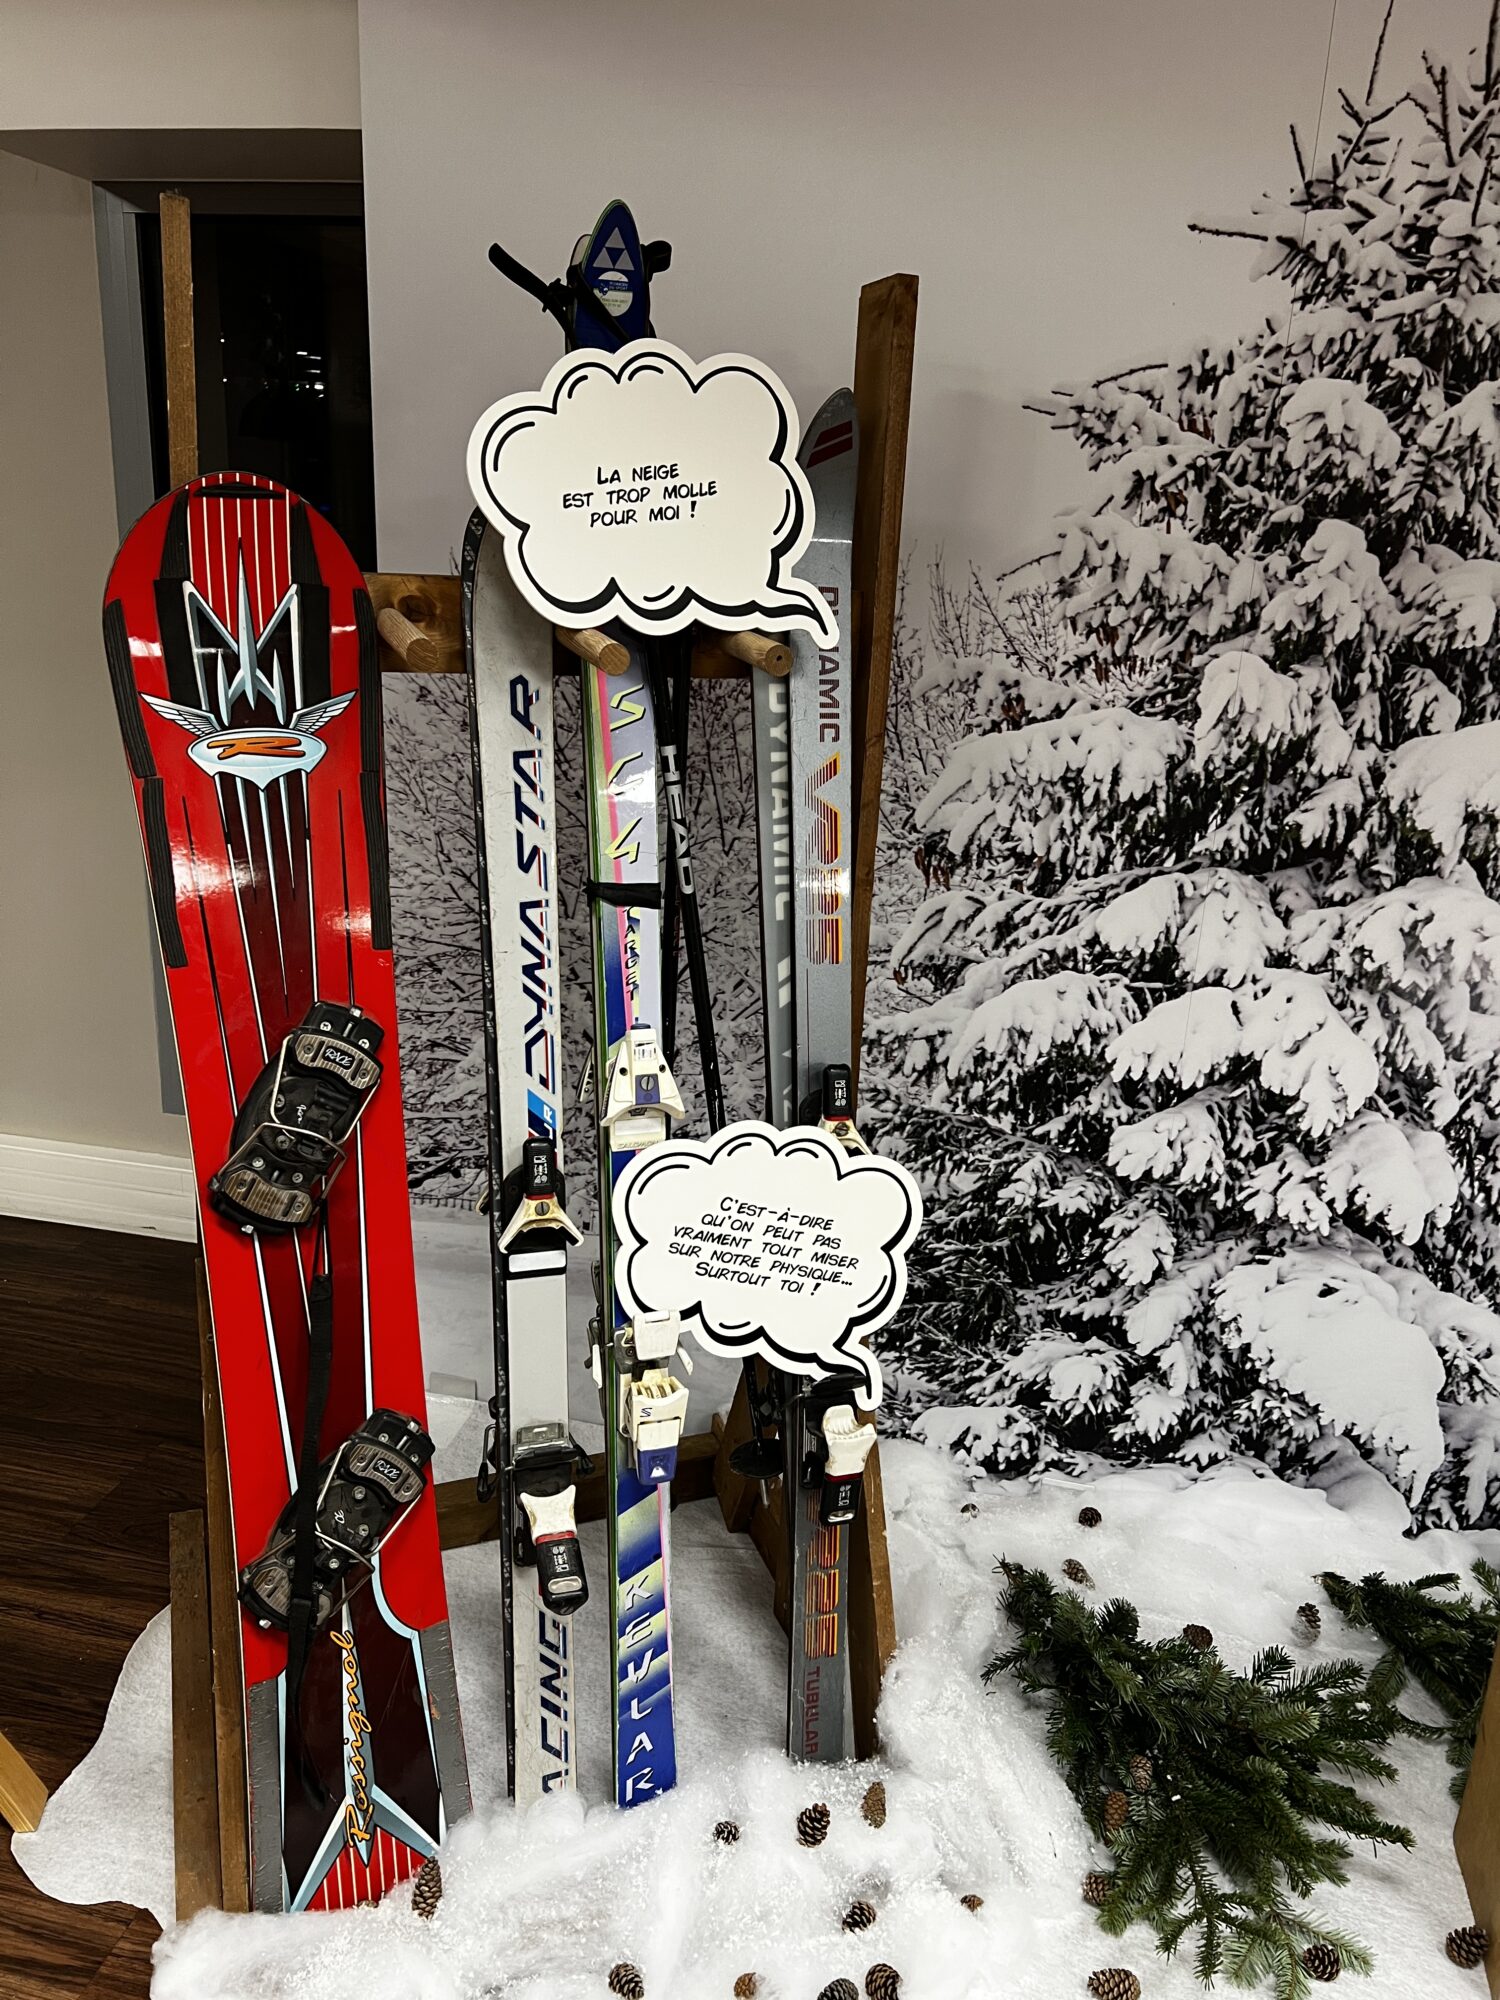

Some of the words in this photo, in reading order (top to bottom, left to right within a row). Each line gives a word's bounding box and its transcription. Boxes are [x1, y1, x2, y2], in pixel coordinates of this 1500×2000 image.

[562, 491, 594, 509] EST
[606, 487, 650, 504] TROP
[663, 481, 717, 499] MOLLE
[597, 466, 621, 485] LA
[632, 463, 679, 482] NEIGE
[590, 508, 638, 527] POUR
[649, 505, 680, 522] MOI
[818, 586, 840, 743] DAMIC
[660, 744, 694, 894] HEAD
[509, 674, 556, 1095] DYNASTAR
[622, 905, 640, 1001] TARGET
[668, 1242, 701, 1258] SUR
[711, 1250, 762, 1268] NOTRE
[769, 1260, 853, 1286] PHYSIQUE...
[674, 1226, 752, 1249] VRAIMENT
[762, 1243, 803, 1259] TOUT
[811, 1251, 859, 1270] MISER
[701, 1213, 755, 1233] QU'ON
[763, 1224, 805, 1242] PEUT
[813, 1235, 842, 1250] PAS
[695, 1261, 771, 1287] SURTOUT
[781, 1279, 805, 1294] TOI
[625, 1575, 656, 1802] KEVLAR
[805, 1666, 820, 1756] TUBULAR
[330, 1630, 375, 1848] Rossignol
